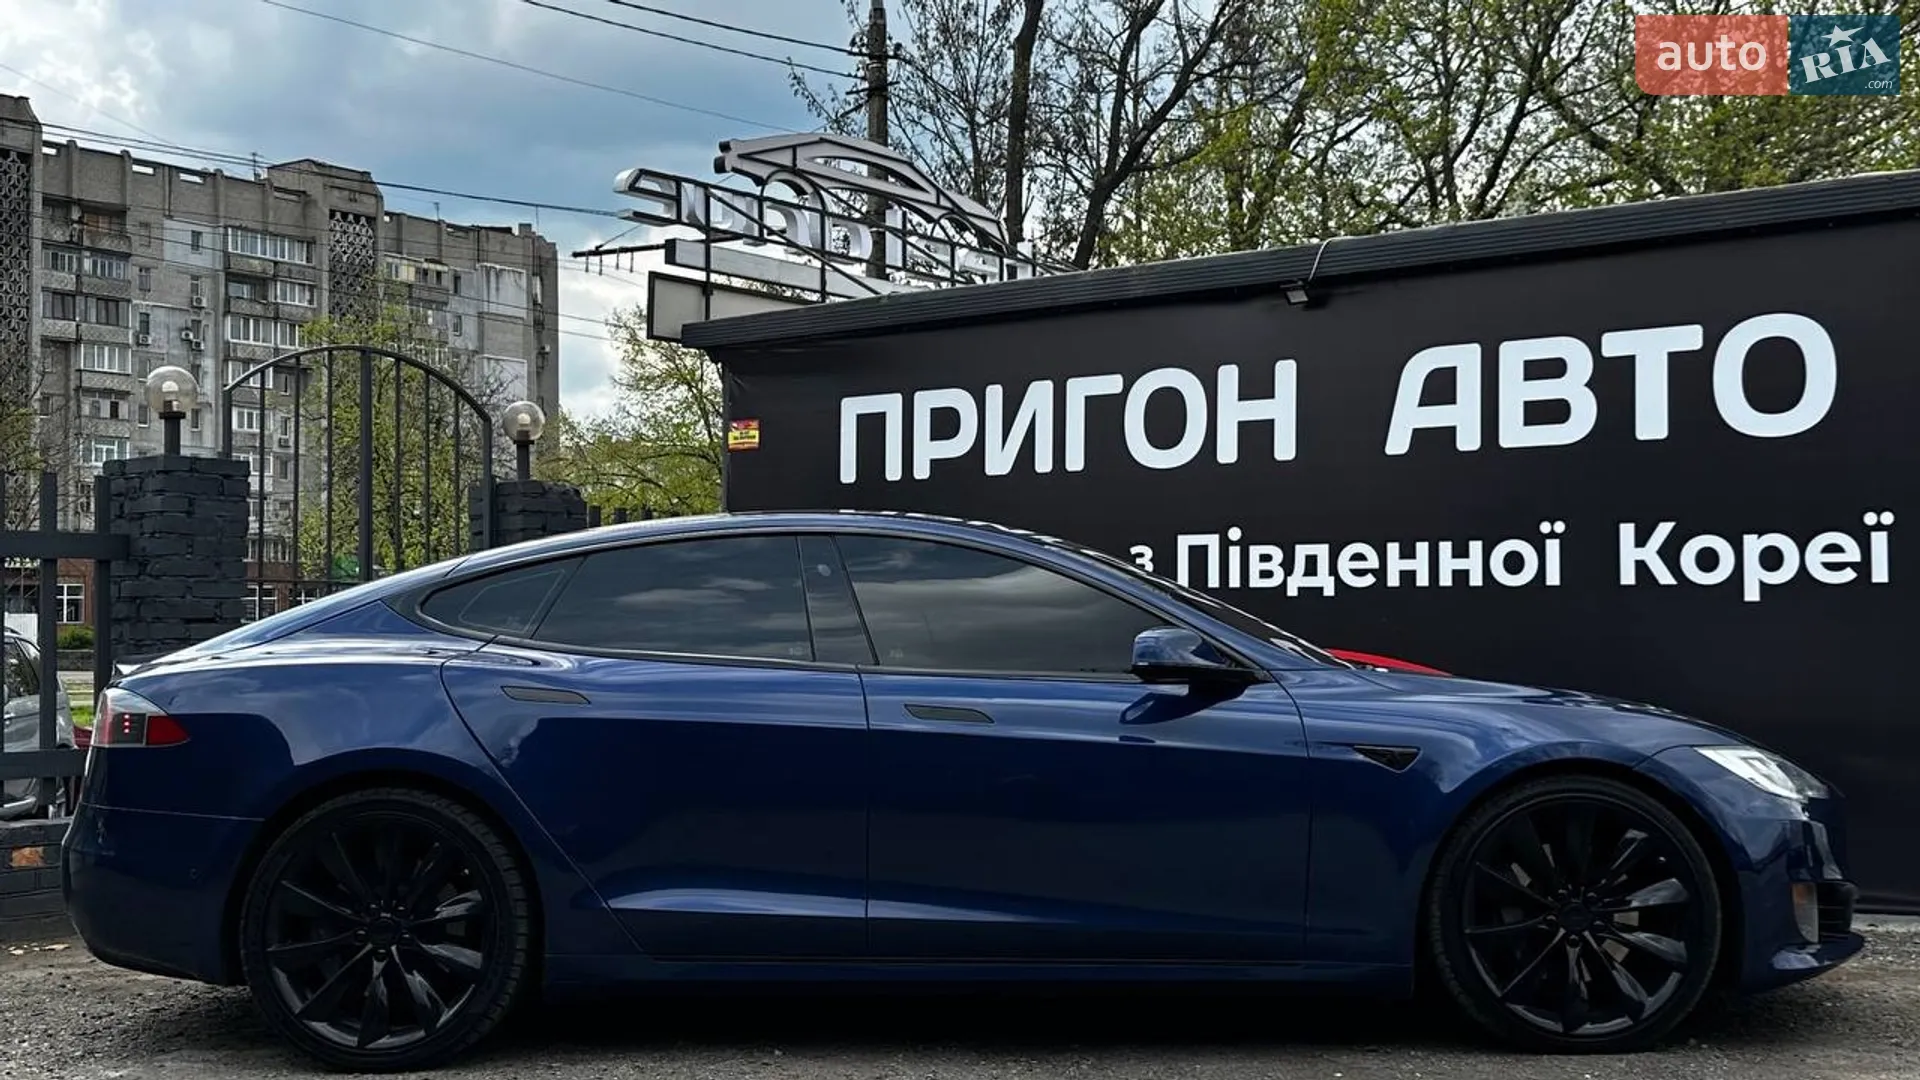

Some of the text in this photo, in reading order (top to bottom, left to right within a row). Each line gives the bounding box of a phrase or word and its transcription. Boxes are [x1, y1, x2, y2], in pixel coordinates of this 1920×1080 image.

[839, 312, 1838, 484] ПРИГОН АВТО
[1129, 511, 1896, 602] з Південної Кореї
